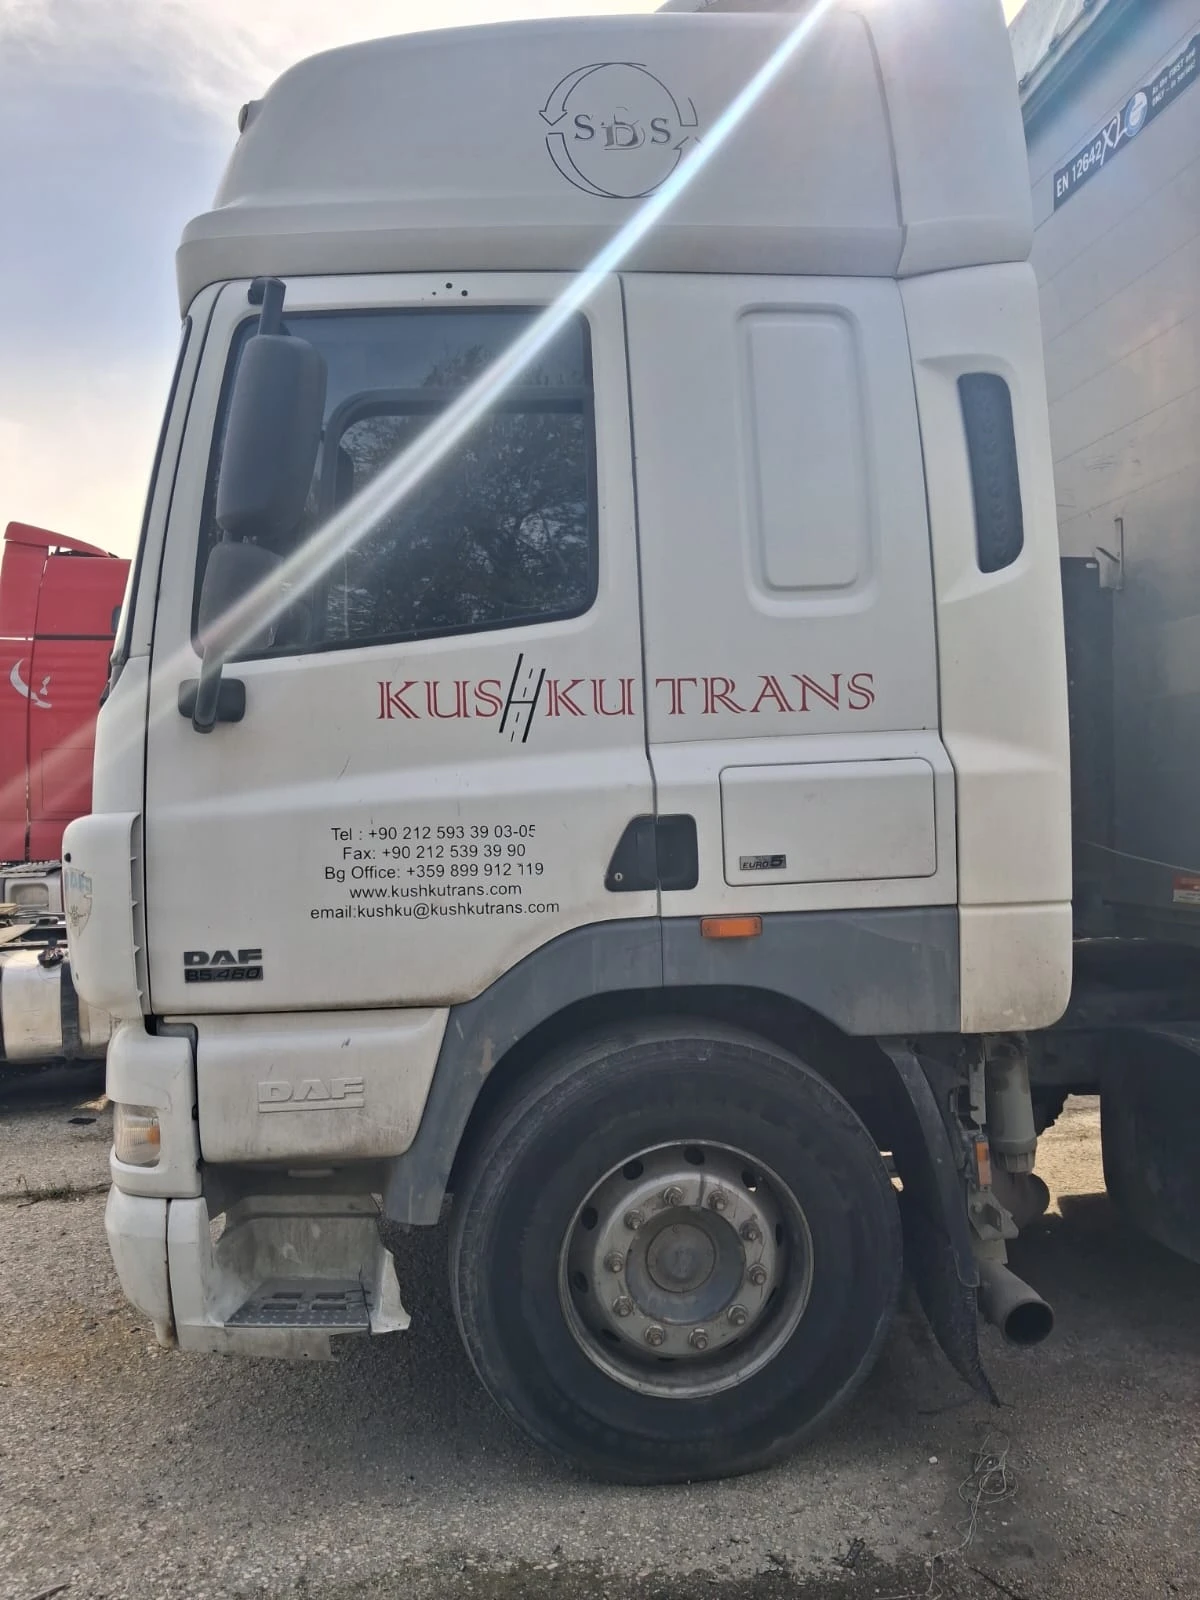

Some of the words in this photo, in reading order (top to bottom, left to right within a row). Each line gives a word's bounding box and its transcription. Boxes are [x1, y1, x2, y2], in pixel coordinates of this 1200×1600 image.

[1169, 58, 1184, 79] FIRST
[1056, 173, 1069, 198] EN
[1072, 140, 1101, 182] 12642
[655, 672, 875, 717] TRANS
[331, 827, 352, 841] Tel
[368, 826, 397, 840] +90
[402, 826, 431, 840] 212
[436, 825, 465, 839] 593
[469, 825, 489, 839] 39
[494, 824, 536, 838] 03-05
[343, 846, 376, 860] Fax:
[381, 845, 411, 859] +90
[416, 845, 444, 859] 212
[450, 844, 478, 858] 539
[483, 844, 502, 858] 39
[507, 843, 526, 857] 90
[325, 866, 345, 882] Bg
[351, 864, 400, 879] Office:
[406, 864, 445, 878] +359
[450, 863, 478, 877] 899
[483, 863, 512, 877] 912
[517, 862, 544, 876] 119
[349, 883, 522, 899] www.kushkutrans.com
[310, 900, 560, 920] email:kushku@kushkutrans.com
[184, 949, 262, 966] DAF
[258, 1077, 364, 1103] DAF
